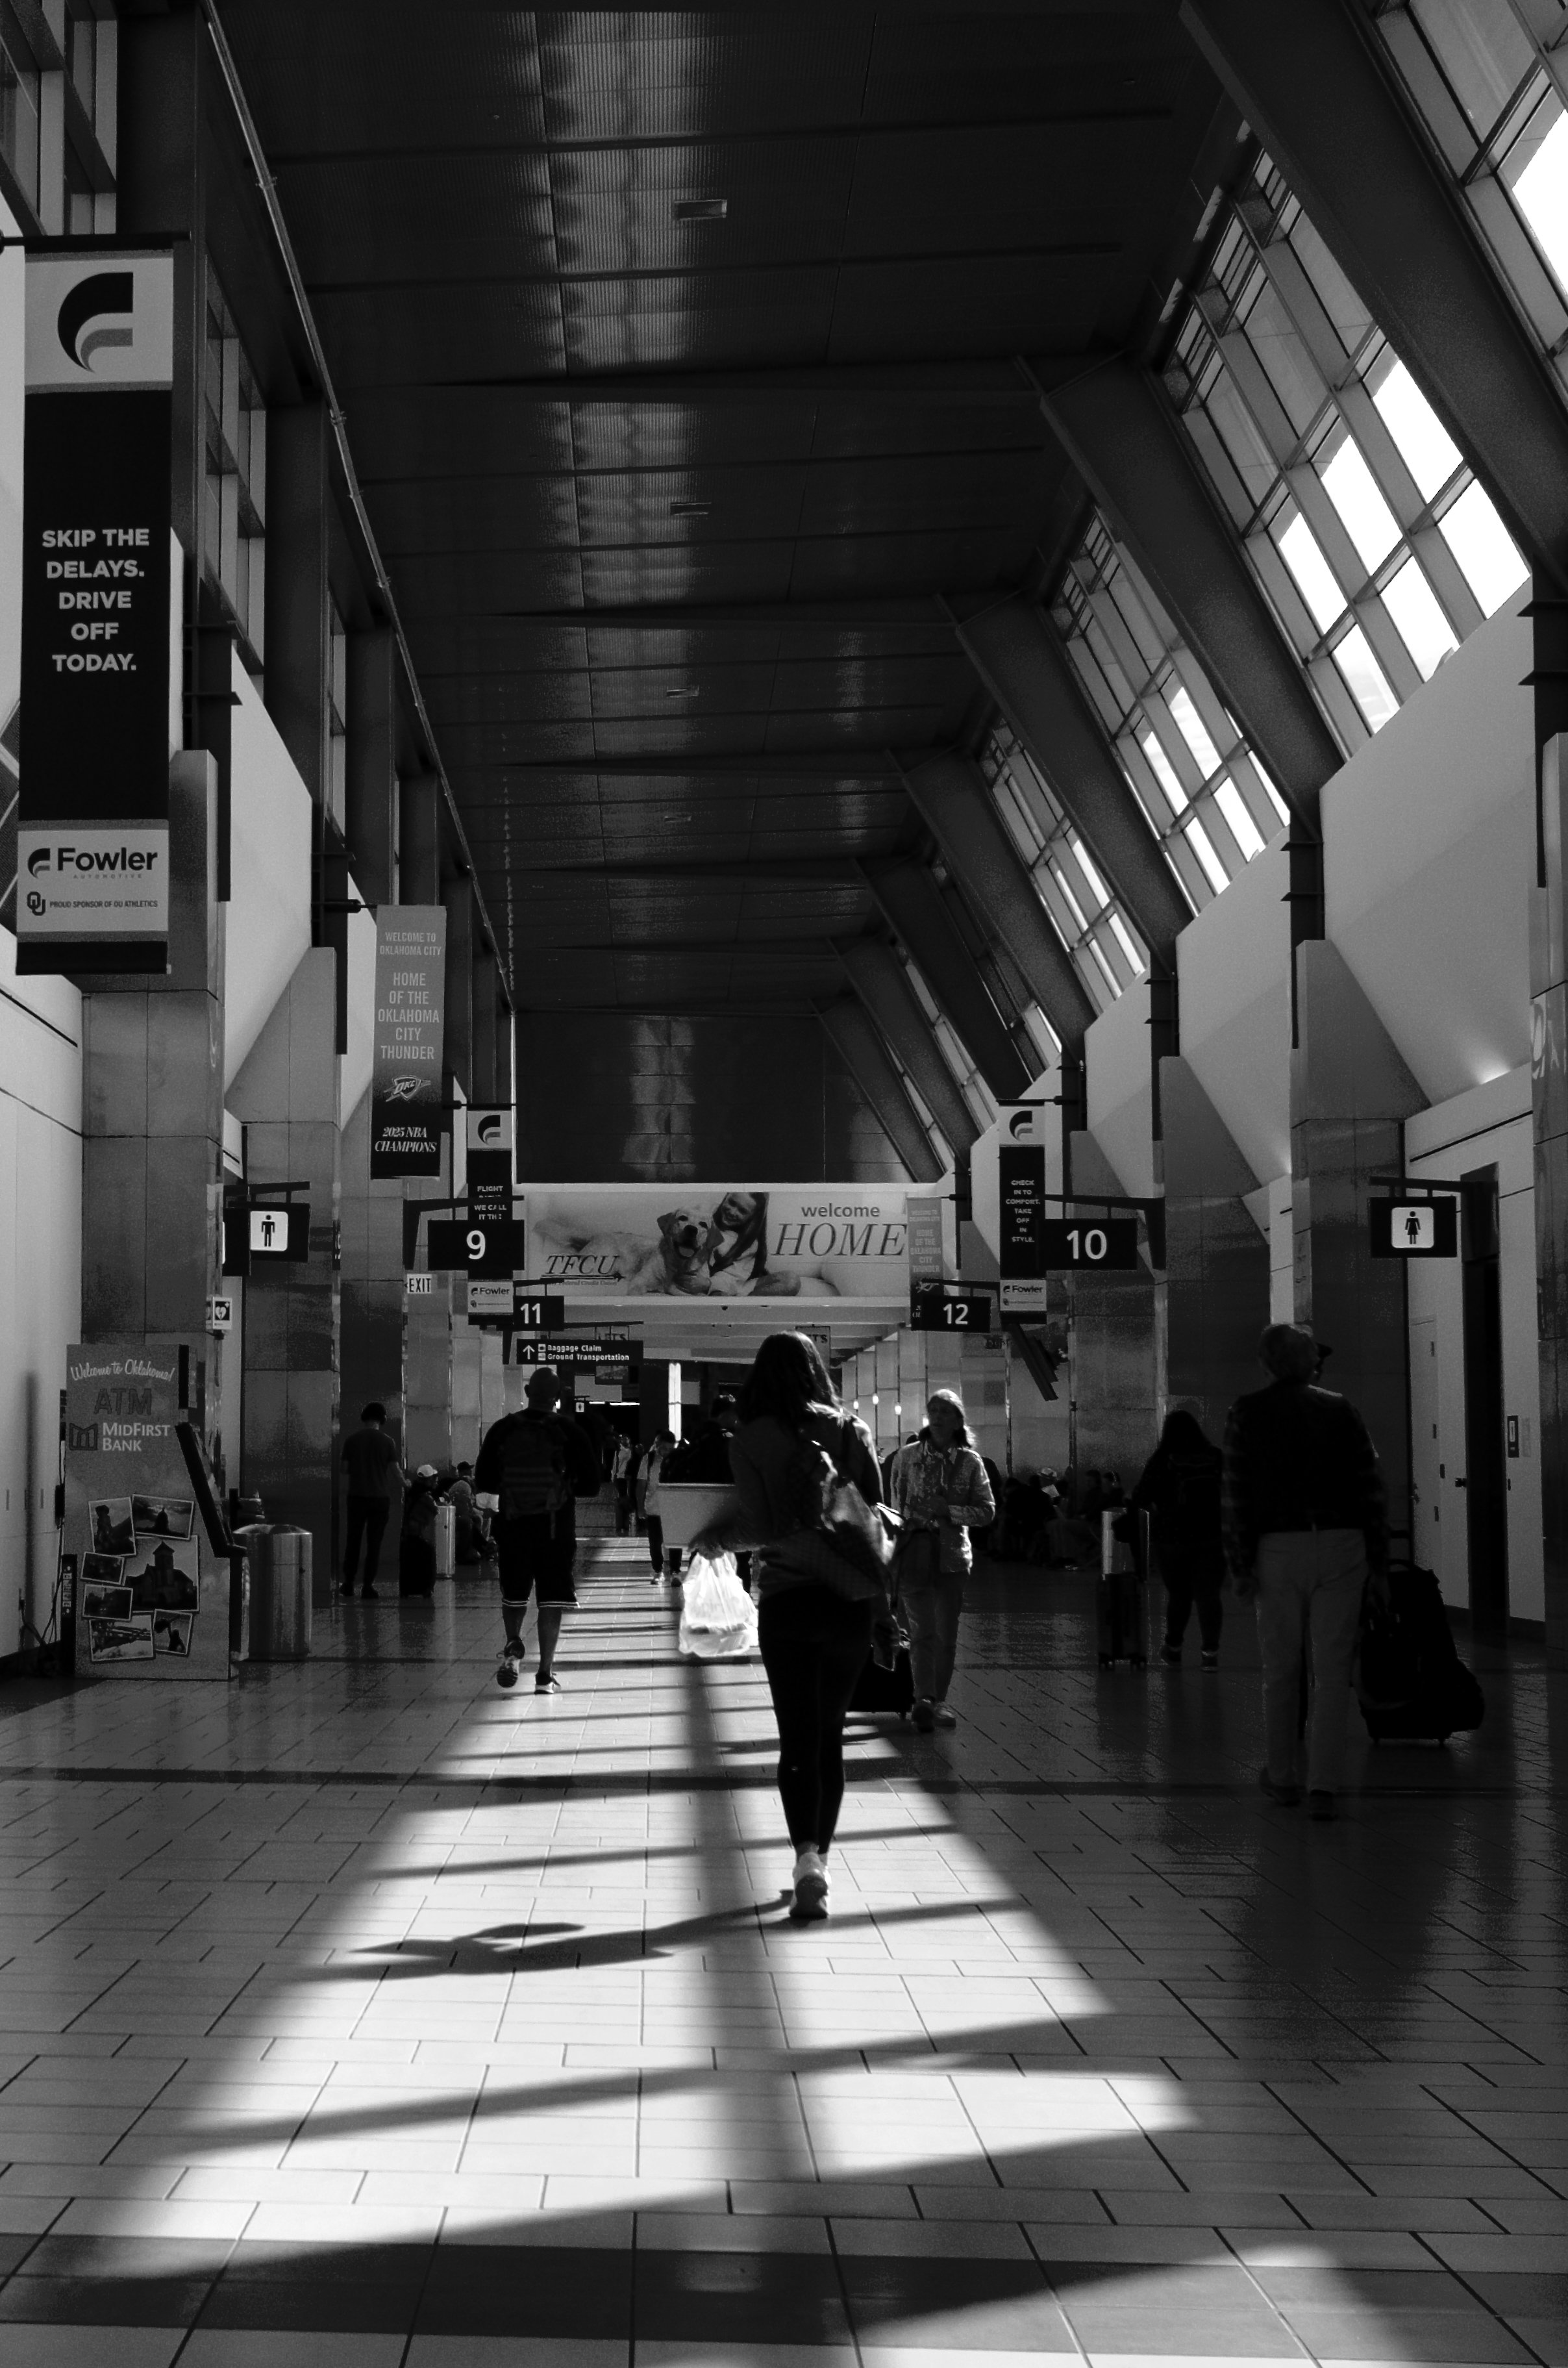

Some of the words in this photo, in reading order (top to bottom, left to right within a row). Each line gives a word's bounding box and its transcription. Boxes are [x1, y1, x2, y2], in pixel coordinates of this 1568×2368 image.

[42, 529, 96, 548] SKIP
[102, 528, 150, 547] THE
[46, 559, 145, 579] DELAYS.
[58, 591, 132, 610] DRIVE
[71, 622, 119, 642] OFF
[52, 653, 137, 673] TODAY.
[58, 847, 158, 871] Fowler
[385, 933, 424, 942] WELCOME
[427, 933, 436, 942] TO
[380, 946, 422, 955] OKLAHOMA
[424, 946, 442, 955] CITY
[393, 973, 426, 986] HOME
[390, 991, 404, 1004] OF
[408, 991, 429, 1004] THE
[378, 1009, 440, 1022] OKLAHOMA
[395, 1027, 421, 1041] CITY
[380, 1046, 434, 1059] THUNDER
[382, 1127, 405, 1137] 2025
[406, 1127, 427, 1138] NBA
[375, 1140, 437, 1152] CHAMPIONS
[801, 1203, 880, 1217] welcome
[466, 1230, 486, 1259] 9
[771, 1223, 908, 1255] HOME
[1066, 1229, 1108, 1261] 10
[545, 1255, 619, 1274] TFCU
[409, 1277, 431, 1293] EXIT
[520, 1303, 541, 1324] 11
[943, 1304, 969, 1325] 12
[547, 1344, 579, 1353] Baggage
[71, 1362, 112, 1381] Welcome
[110, 1361, 123, 1374] to
[125, 1359, 175, 1381] Oklahoma!
[93, 1388, 152, 1415] ATM
